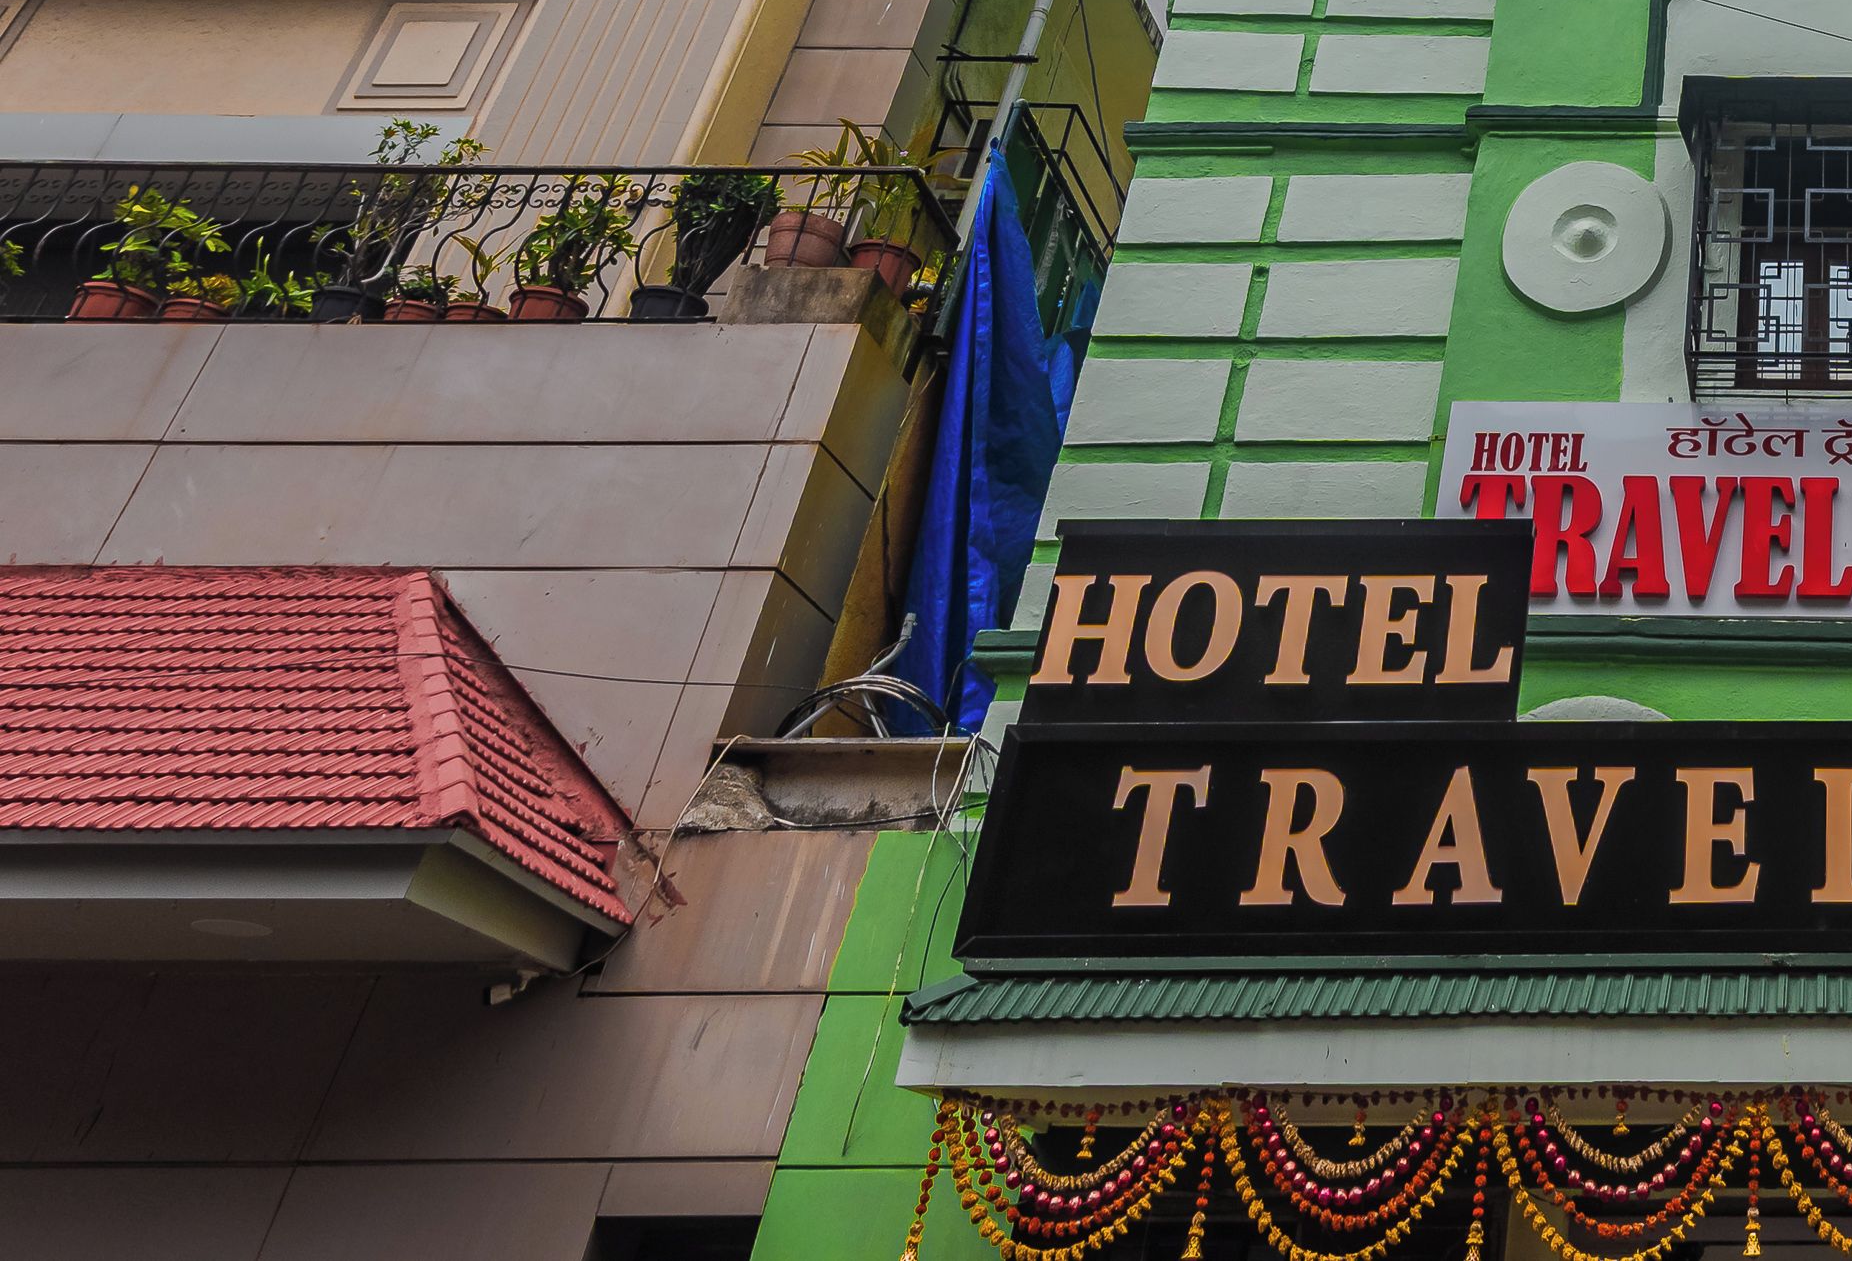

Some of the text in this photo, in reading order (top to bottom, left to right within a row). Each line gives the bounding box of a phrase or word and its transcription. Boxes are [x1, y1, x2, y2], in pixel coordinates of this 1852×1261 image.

[1470, 432, 1588, 473] HOTEL
[1666, 413, 1811, 460] हॉटेल
[1030, 571, 1513, 685] HOTEL
